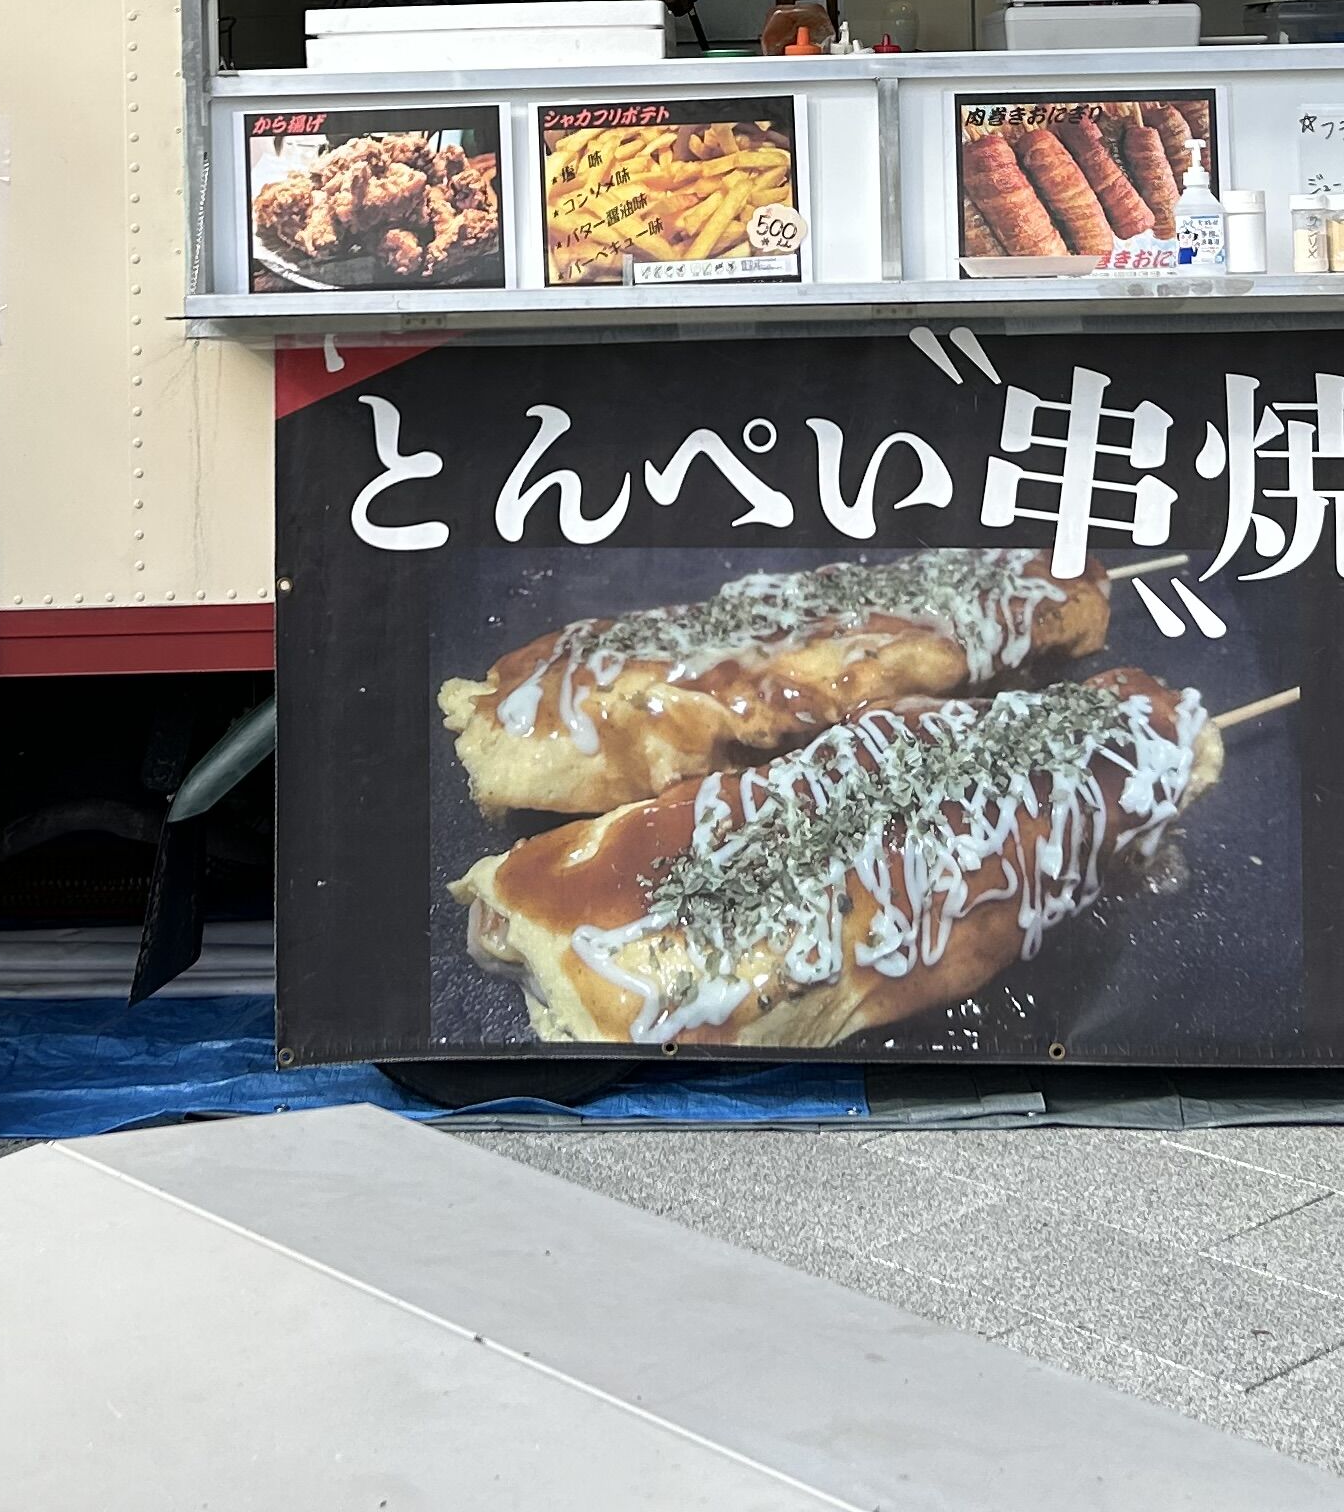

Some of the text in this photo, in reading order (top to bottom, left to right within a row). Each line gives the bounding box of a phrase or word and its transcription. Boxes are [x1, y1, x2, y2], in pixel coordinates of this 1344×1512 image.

[252, 113, 328, 135] から揚げ
[544, 105, 671, 128] シャカフリポテト
[965, 104, 1103, 127] 肉巻きおにぎり
[563, 167, 631, 216] コンソメ味
[756, 214, 798, 240] 500
[568, 217, 665, 279] バーベキュー味
